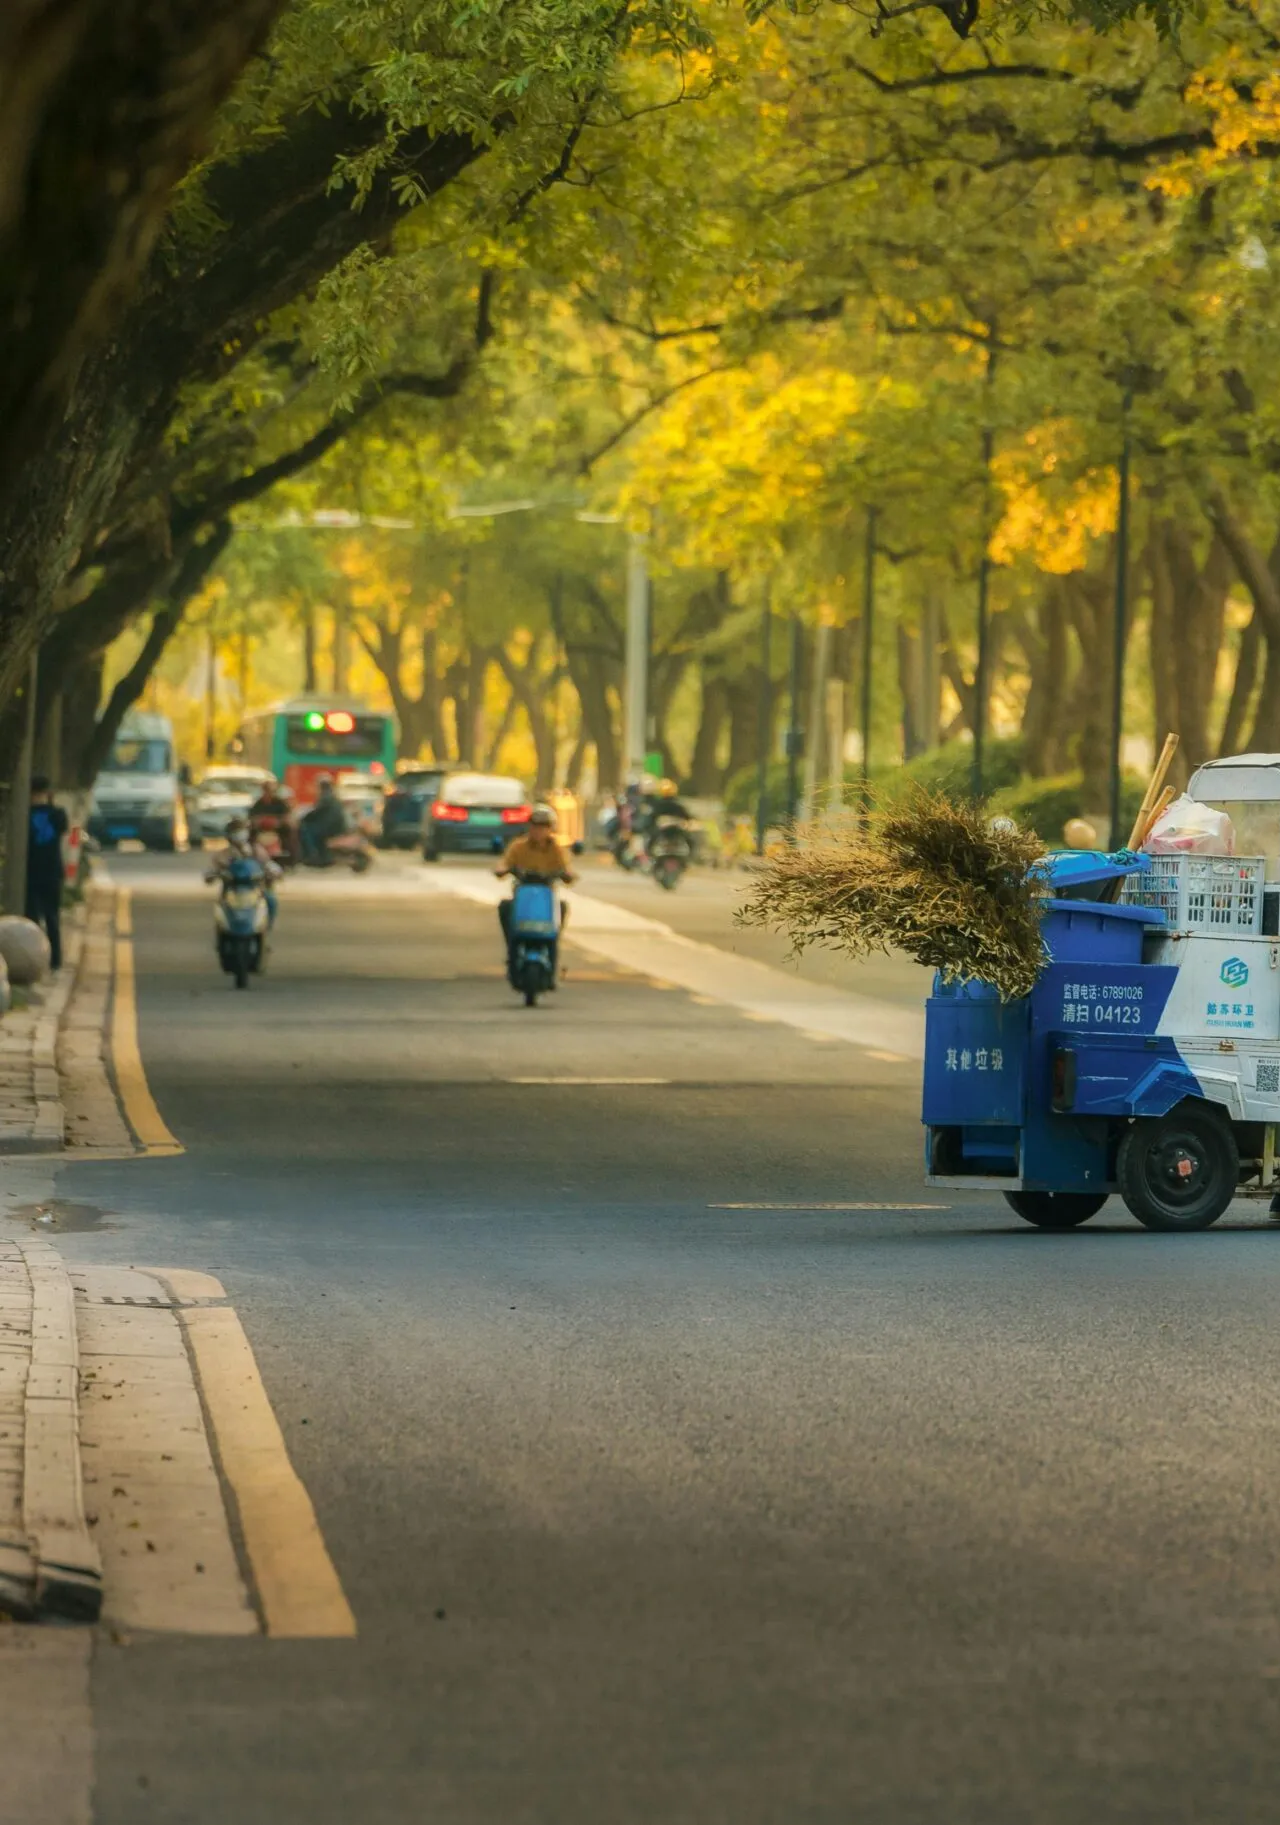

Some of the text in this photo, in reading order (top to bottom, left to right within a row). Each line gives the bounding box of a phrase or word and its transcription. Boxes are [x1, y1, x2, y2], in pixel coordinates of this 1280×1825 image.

[1062, 1003, 1141, 1024] 清扫 04123
[945, 1047, 1003, 1071] 其他垃圾
